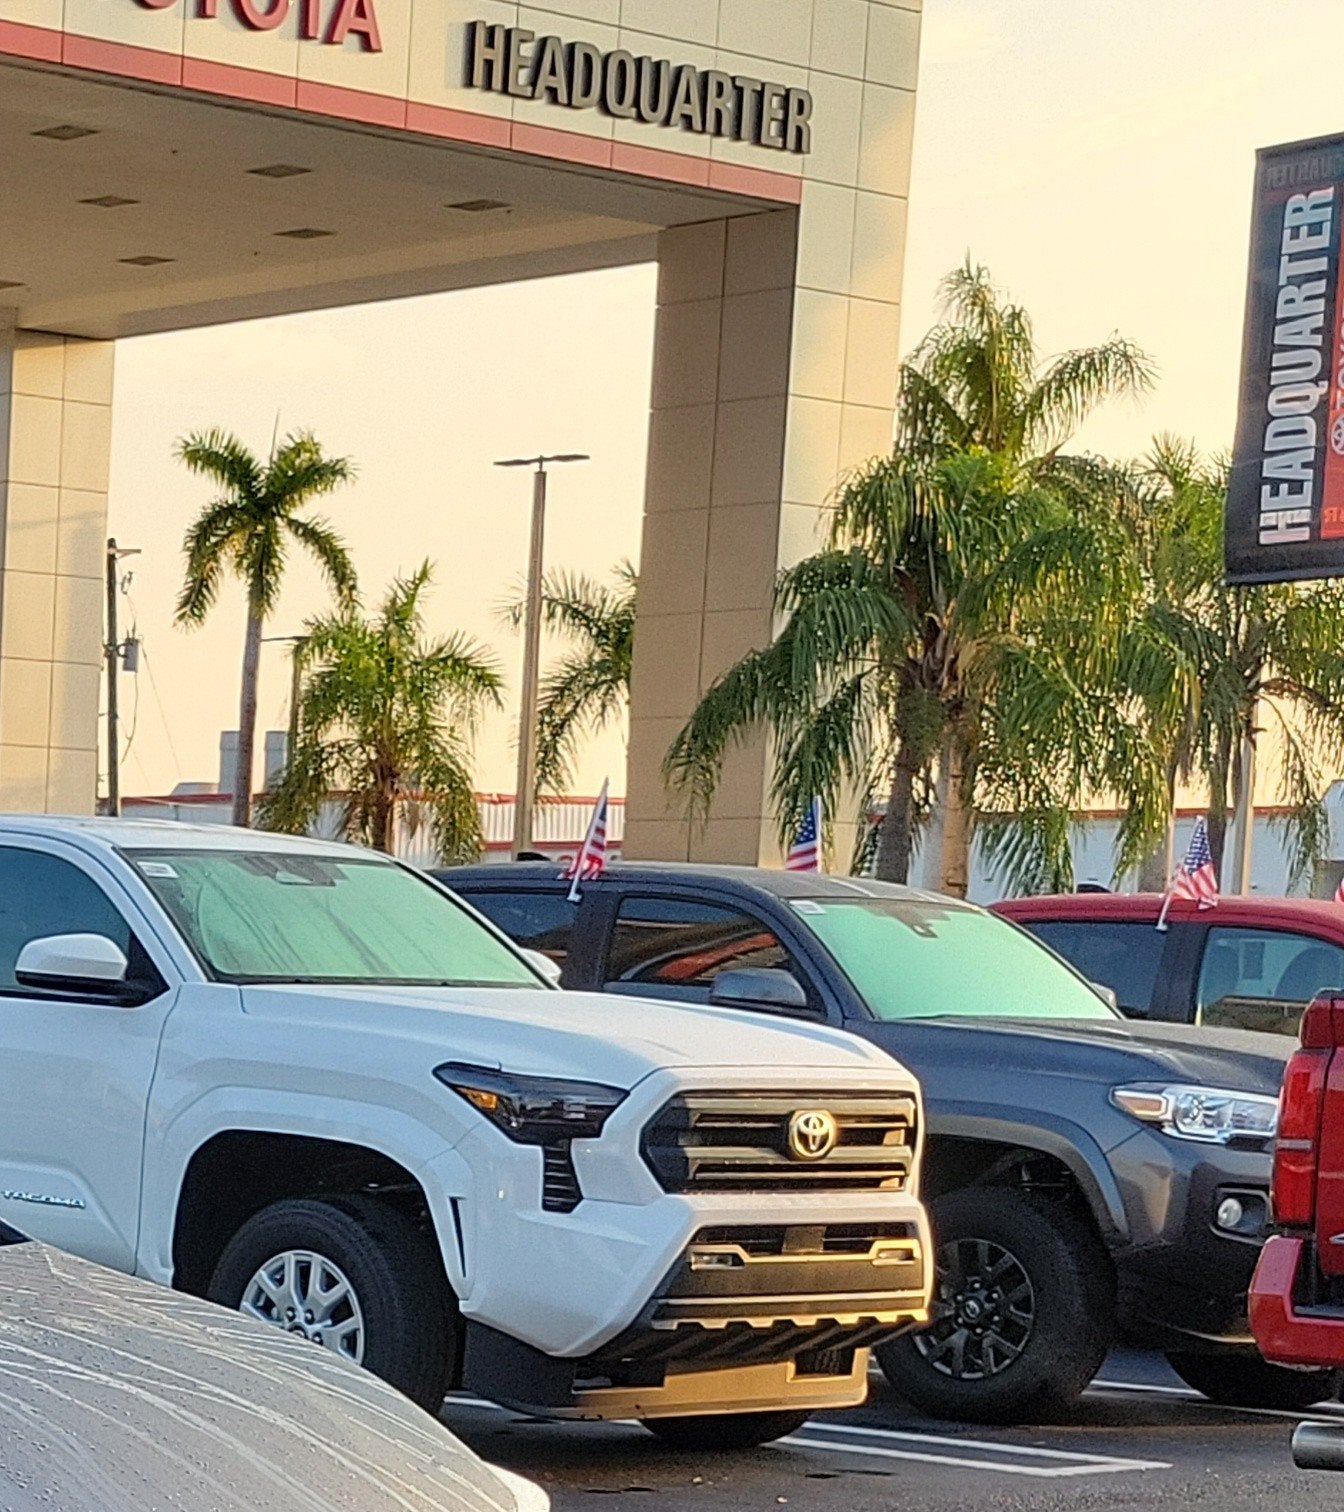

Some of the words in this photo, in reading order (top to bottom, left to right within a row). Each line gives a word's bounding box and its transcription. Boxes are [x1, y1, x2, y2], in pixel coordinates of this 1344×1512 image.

[464, 20, 813, 155] HEADQUARTER
[1259, 186, 1335, 545] HEADQUARTER
[1, 1190, 86, 1209] TACOMA
